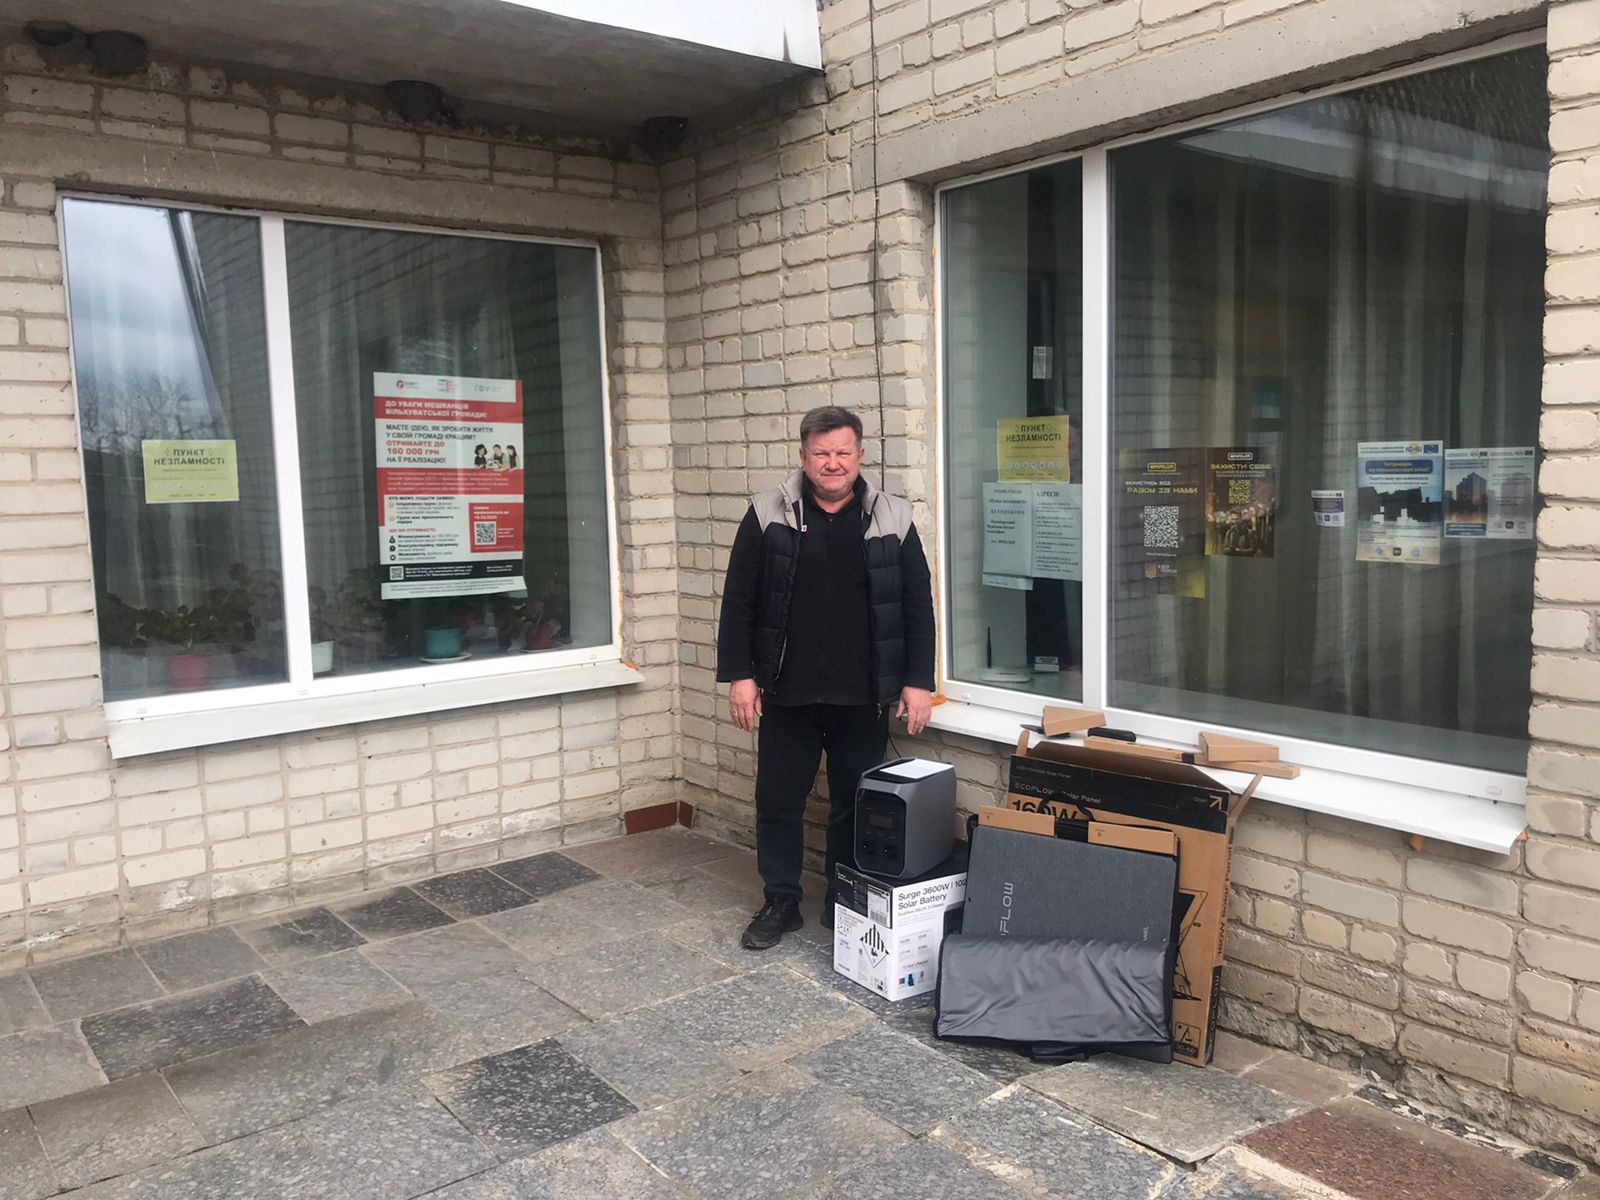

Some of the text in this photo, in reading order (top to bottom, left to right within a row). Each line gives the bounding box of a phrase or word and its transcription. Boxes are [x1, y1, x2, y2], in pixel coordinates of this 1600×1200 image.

[398, 401, 423, 409] УВАГИ
[1020, 424, 1045, 432] ПУНКТ
[1006, 433, 1061, 442] НЕЗЛАМНОСТІ
[153, 457, 225, 465] НЕЗЛАМНОСТІ
[1081, 794, 1101, 804] Panel
[898, 890, 921, 901] Surge
[922, 883, 949, 895] 3600W
[898, 893, 947, 910] Solar Battery
[1217, 846, 1233, 956] 160W Solar Panel
[1000, 882, 1014, 936] FLOW
